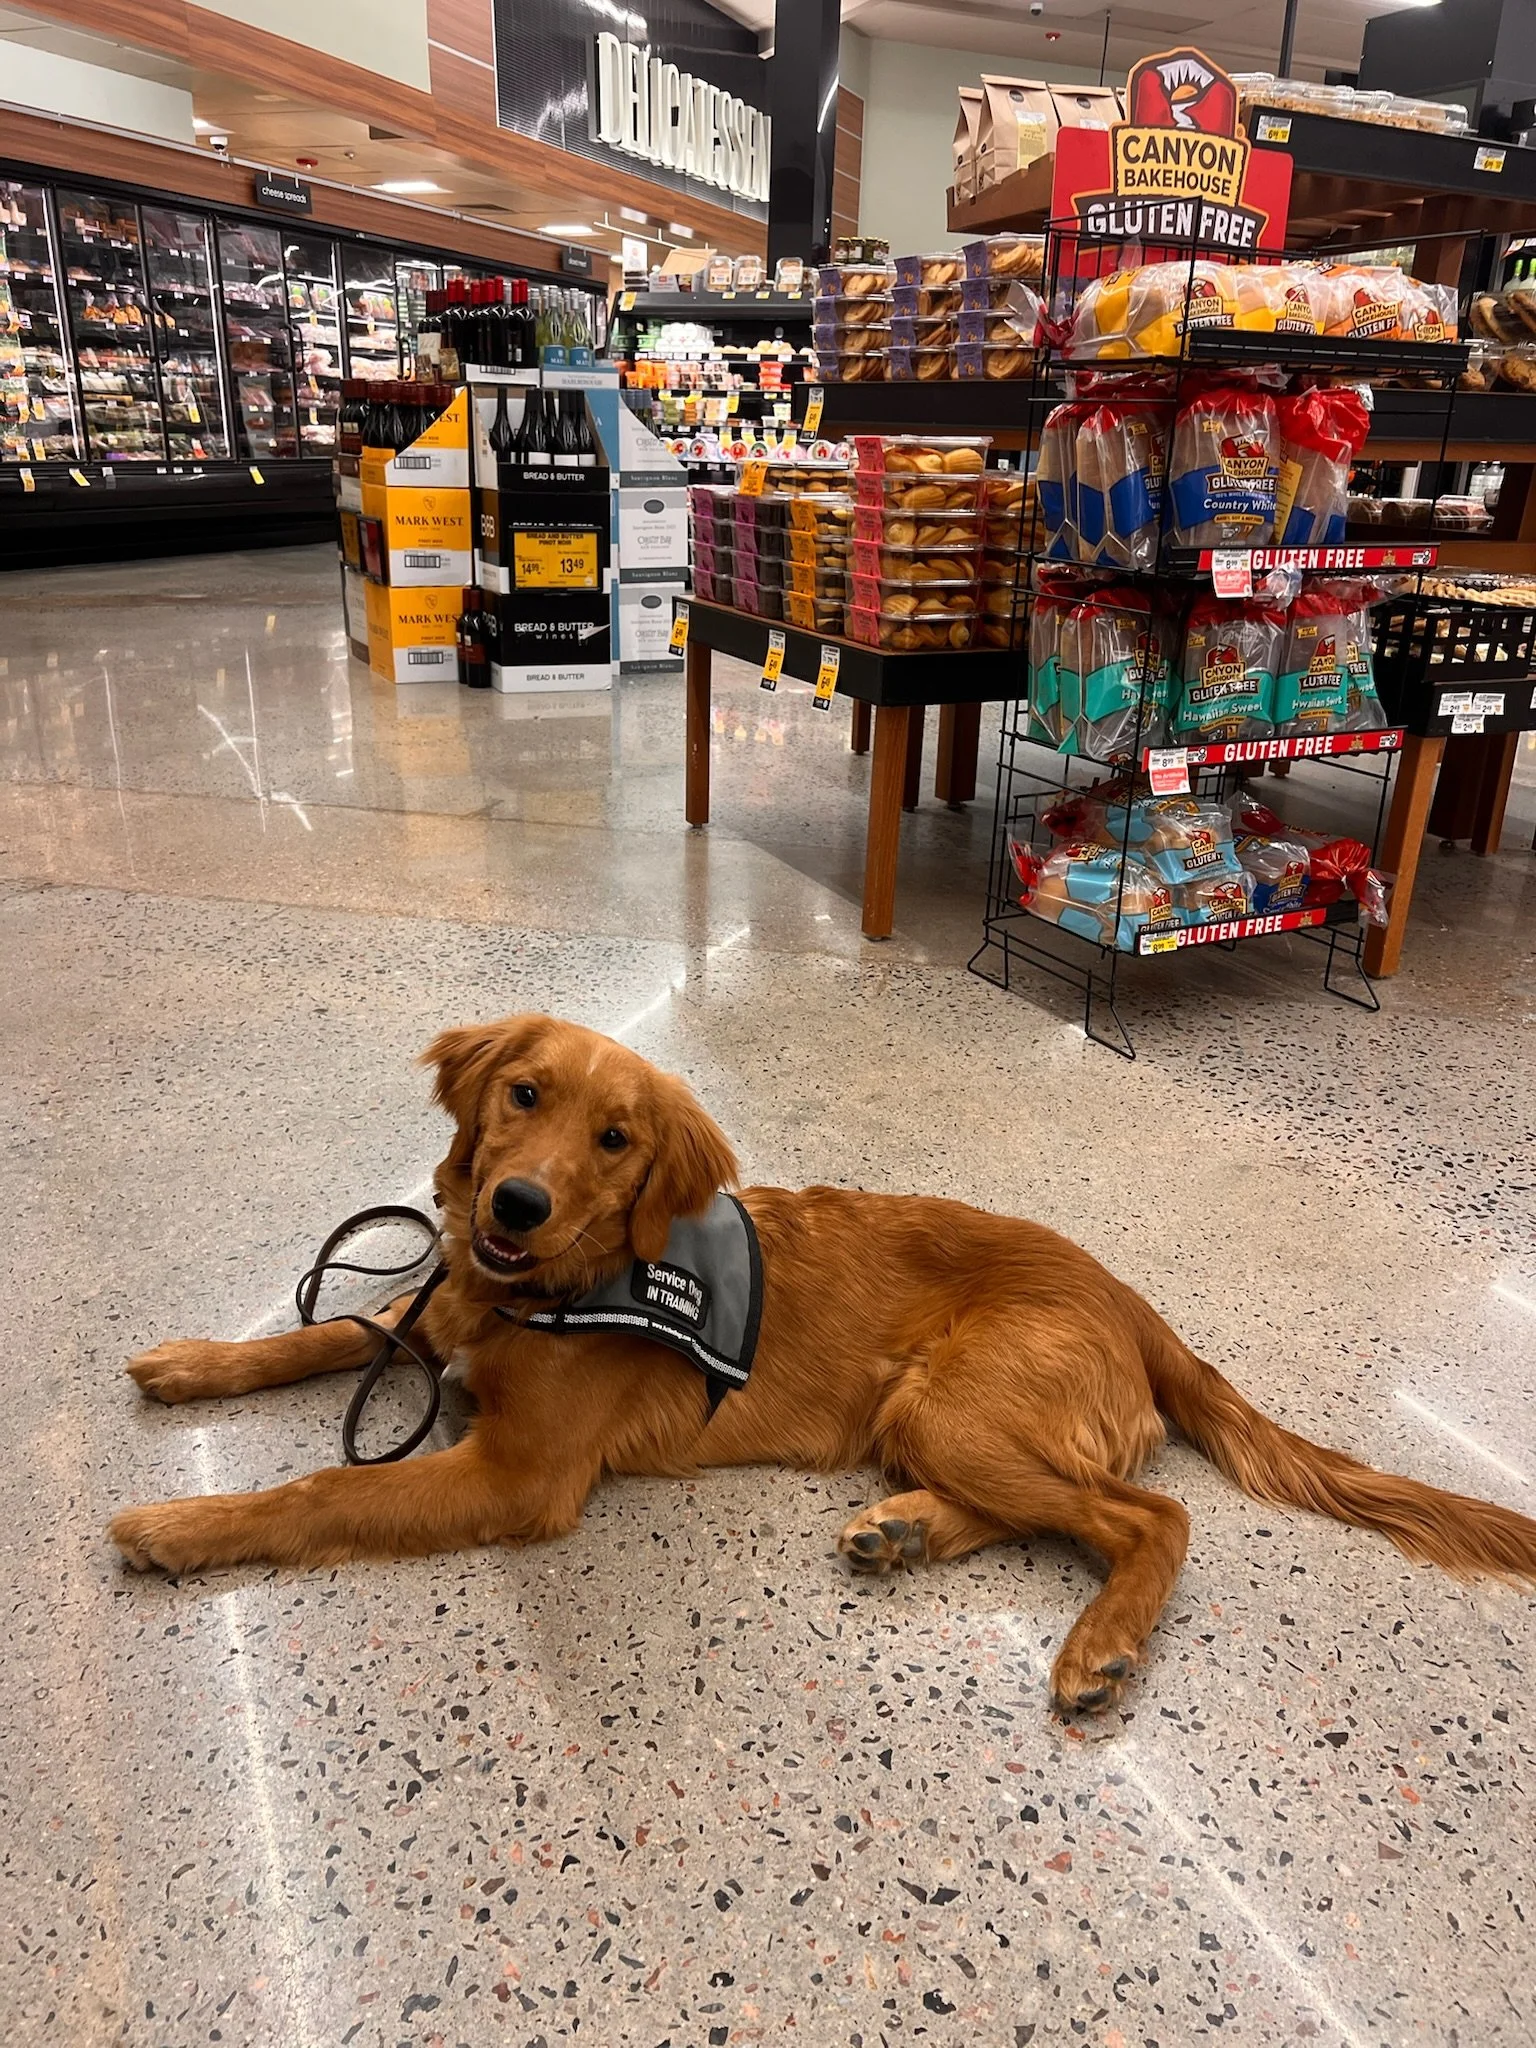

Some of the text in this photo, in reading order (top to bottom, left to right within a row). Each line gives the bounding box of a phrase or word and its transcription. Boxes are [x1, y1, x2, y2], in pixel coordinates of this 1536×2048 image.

[597, 32, 772, 202] DELICATESSEN
[1122, 135, 1237, 175] CANYON
[1124, 168, 1232, 197] BAKEHOUSE
[262, 186, 284, 199] cheese
[1087, 201, 1256, 248] GLUTEN FREE
[1189, 299, 1219, 310] ANYON
[1288, 302, 1312, 313] CANYO
[1176, 319, 1210, 334] GUTEN
[1227, 459, 1265, 468] ANYON
[523, 472, 549, 480] BREAD
[556, 473, 585, 481] BUTTER
[1203, 499, 1249, 512] Country
[395, 516, 464, 526] MARK WEST
[1253, 549, 1365, 569] GLUTEN FREE
[399, 614, 460, 624] MARK WES
[514, 623, 547, 632] BREAD
[1349, 662, 1367, 673] FREE
[1224, 735, 1333, 762] GLUTEN FREE
[1186, 853, 1217, 869] GLUTEN
[1177, 915, 1283, 946] GLUTEN FREE
[647, 1263, 702, 1307] Service Dog
[647, 1285, 699, 1321] IN TRAINING
